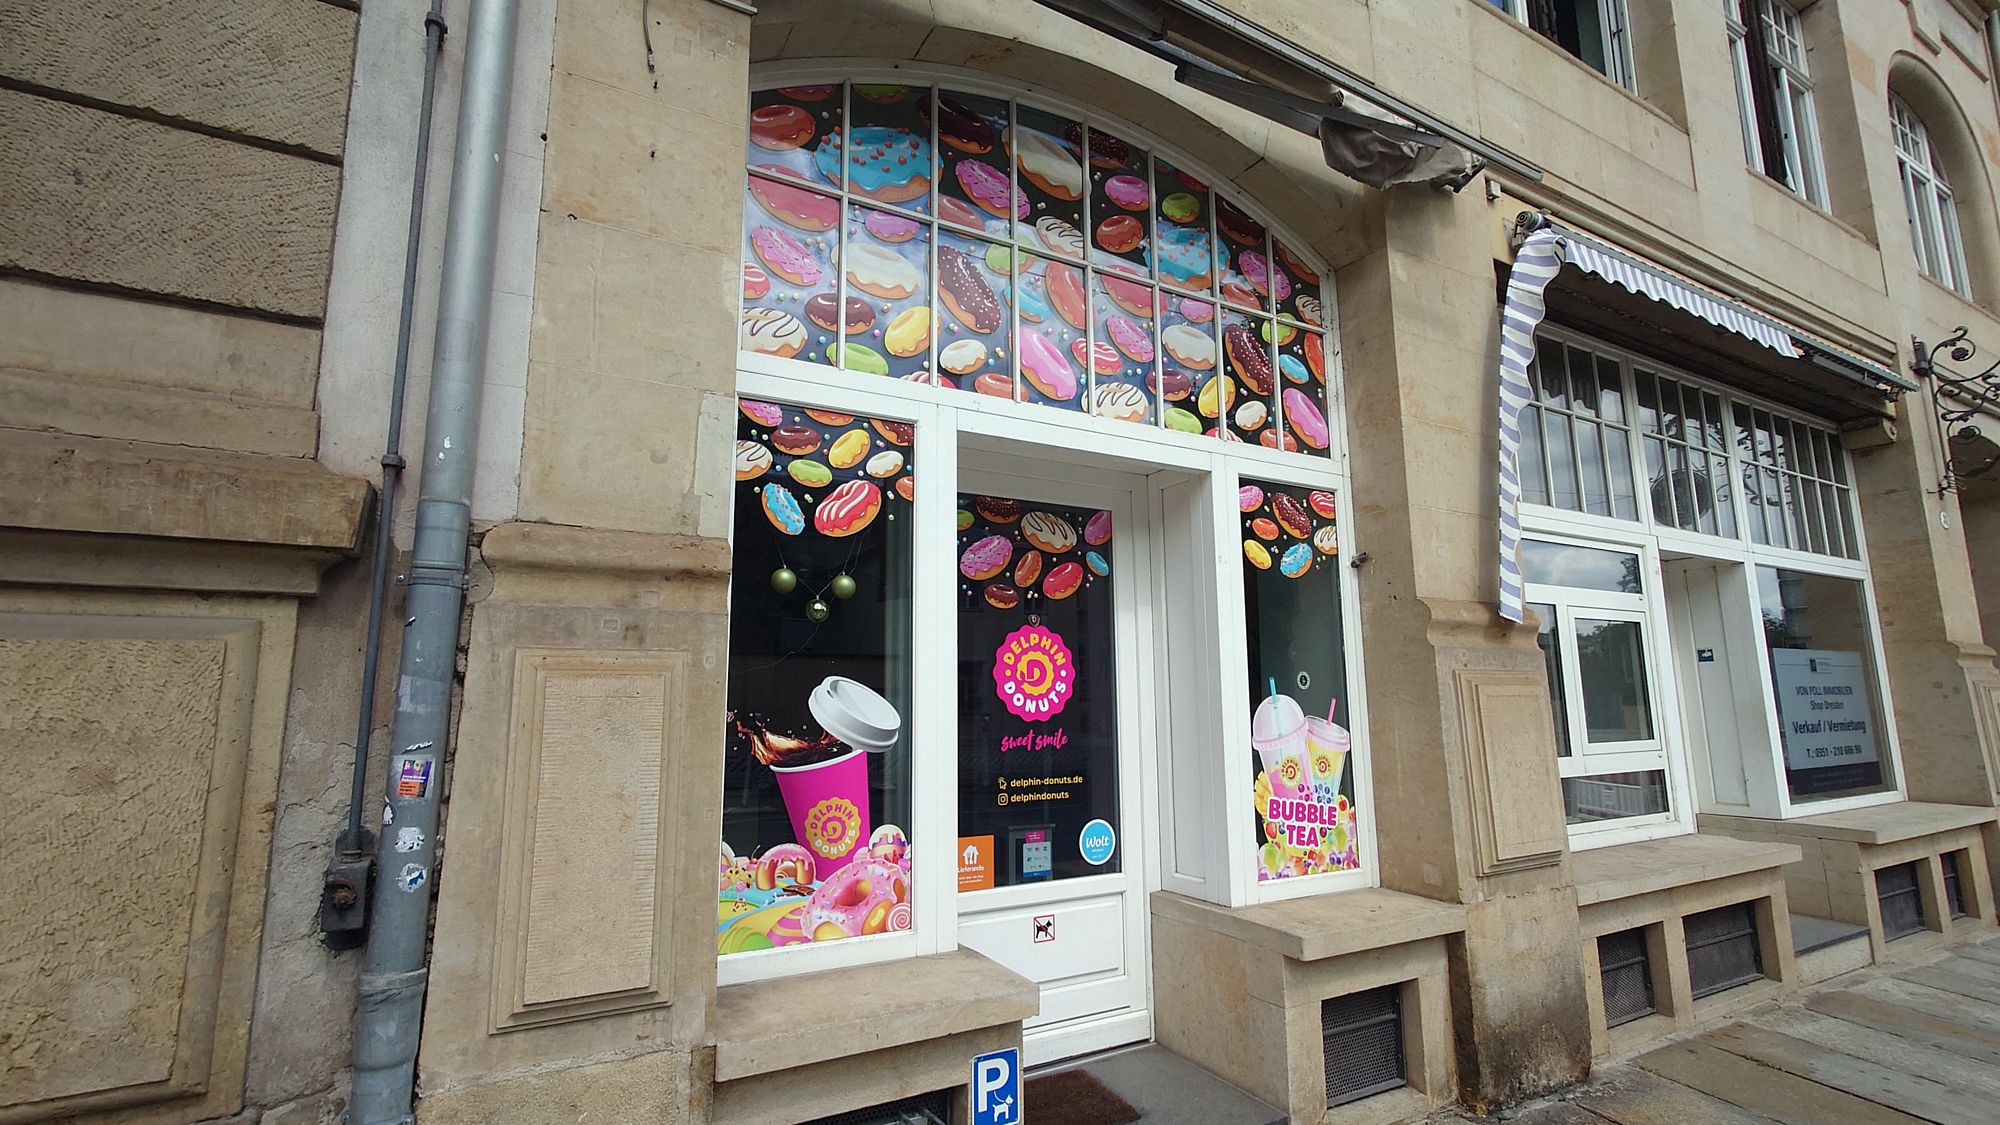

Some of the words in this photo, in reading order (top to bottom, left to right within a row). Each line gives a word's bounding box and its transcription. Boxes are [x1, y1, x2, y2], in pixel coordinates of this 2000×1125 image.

[1003, 633, 1066, 667] DELPHIN
[1003, 680, 1067, 714] DONUTS
[1796, 686, 1808, 695] VON
[1809, 686, 1822, 695] POLL
[1810, 700, 1824, 711] Shop
[1792, 719, 1822, 734] Verkauf
[1826, 719, 1867, 734] Vermietung
[1001, 729, 1034, 752] sweet
[1035, 728, 1069, 751] smile
[1815, 747, 1829, 758] 0351
[1010, 775, 1083, 789] delphin-donuts.de
[1010, 791, 1069, 804] delphindonuts
[810, 804, 854, 829] DELPHIN
[1269, 799, 1337, 826] BUBBLE
[815, 829, 856, 855] DONUTS
[1086, 835, 1109, 848] Wolt
[1286, 824, 1319, 848] TEA
[978, 1058, 1009, 1113] P
